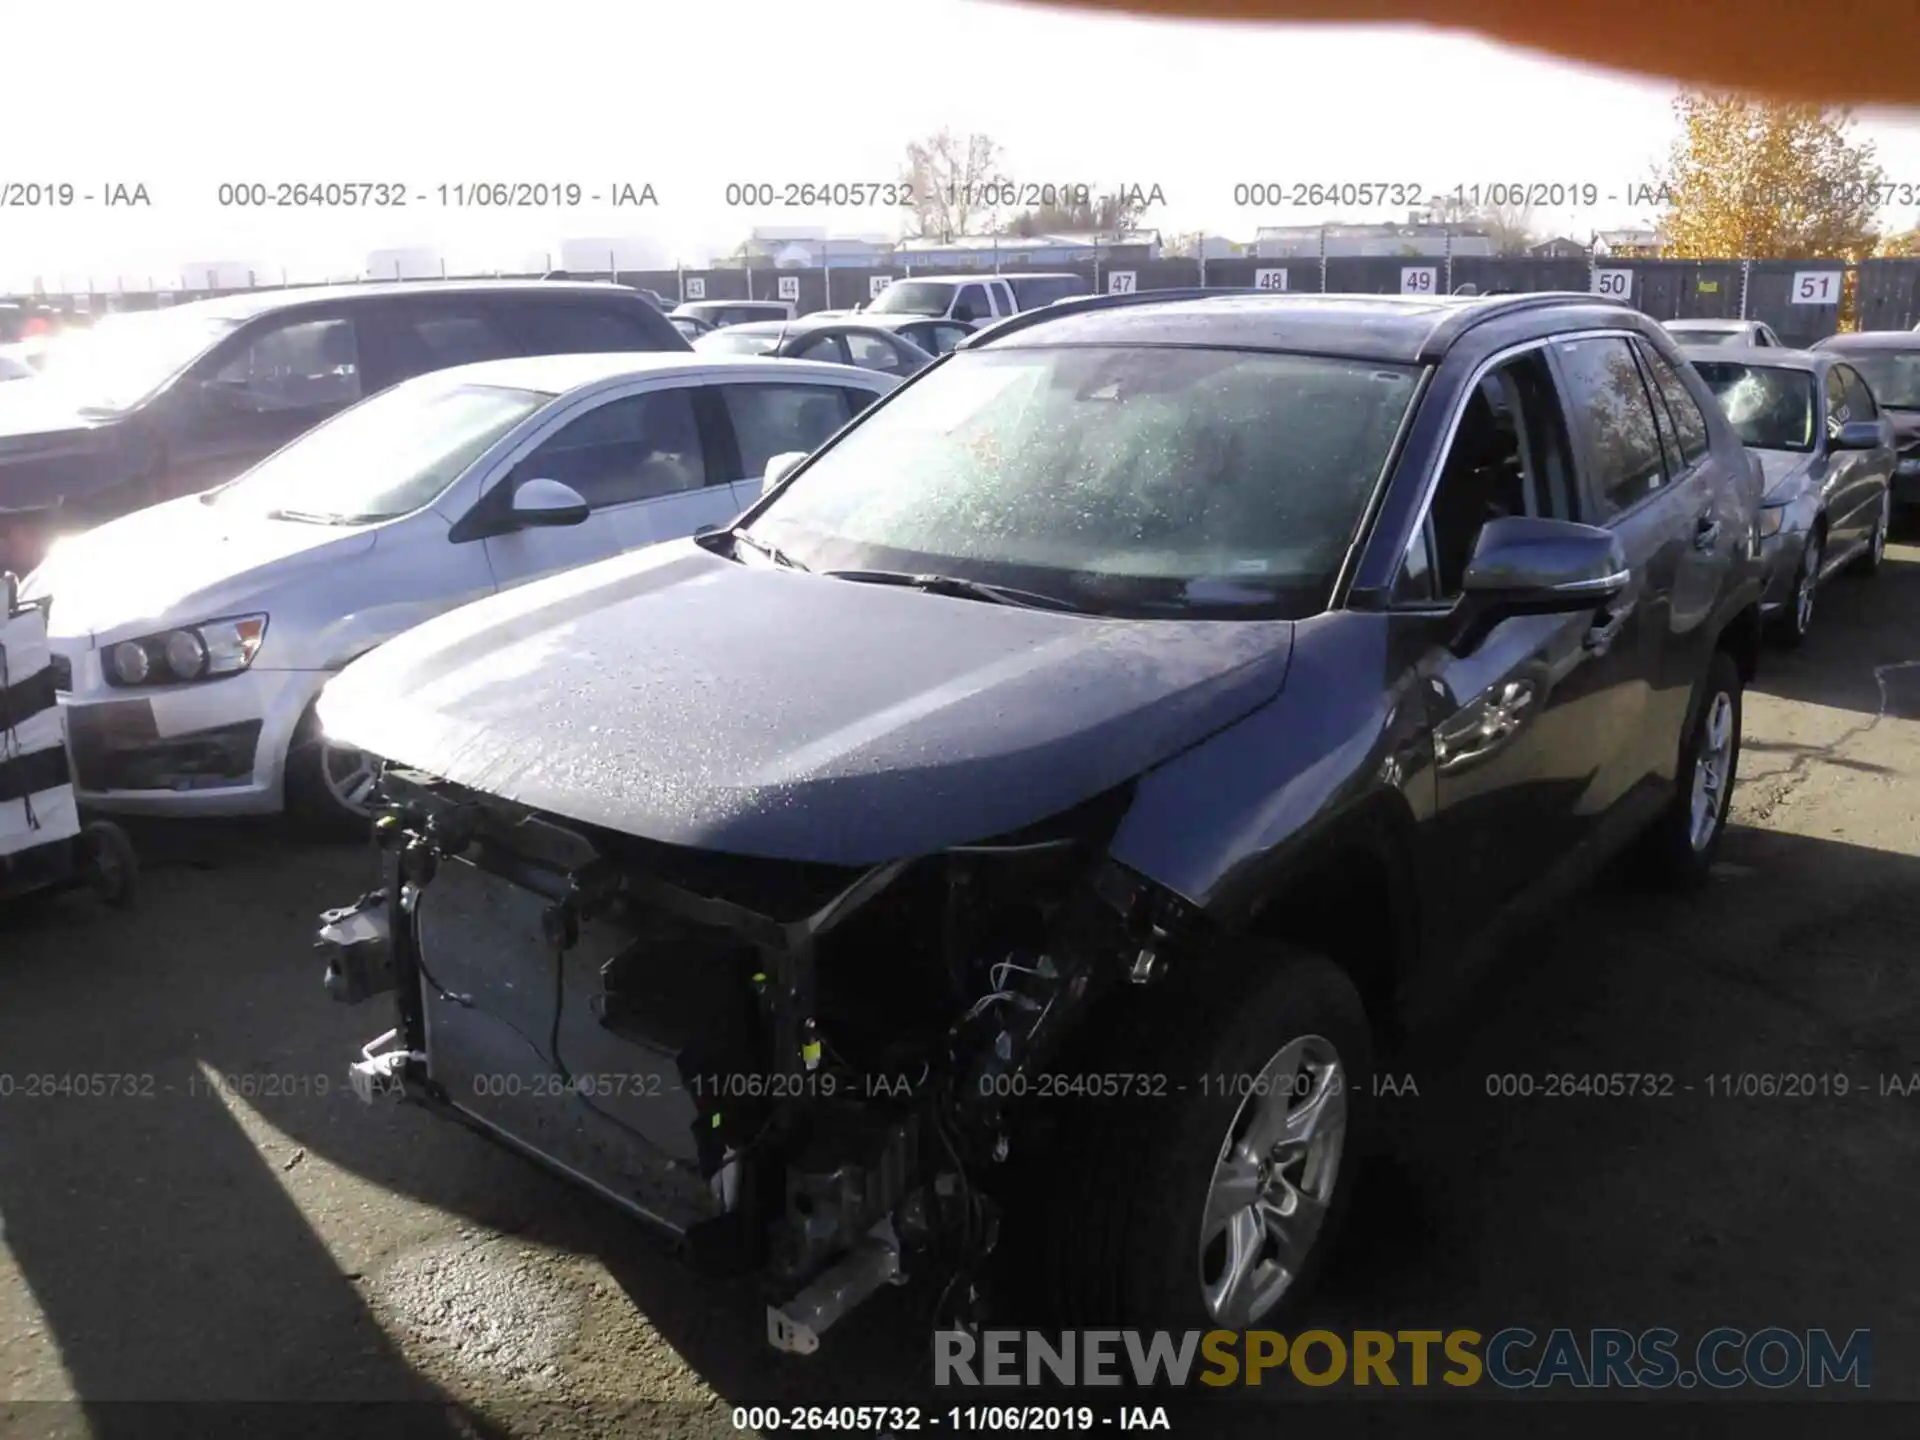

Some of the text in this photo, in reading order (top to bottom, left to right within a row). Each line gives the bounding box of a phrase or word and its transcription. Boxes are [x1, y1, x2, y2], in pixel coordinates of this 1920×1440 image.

[783, 279, 796, 295] 44
[1112, 275, 1131, 293] 47
[1260, 273, 1282, 289] 48
[1407, 271, 1430, 291] 49
[1599, 274, 1625, 294] 50
[1800, 276, 1830, 298] 51
